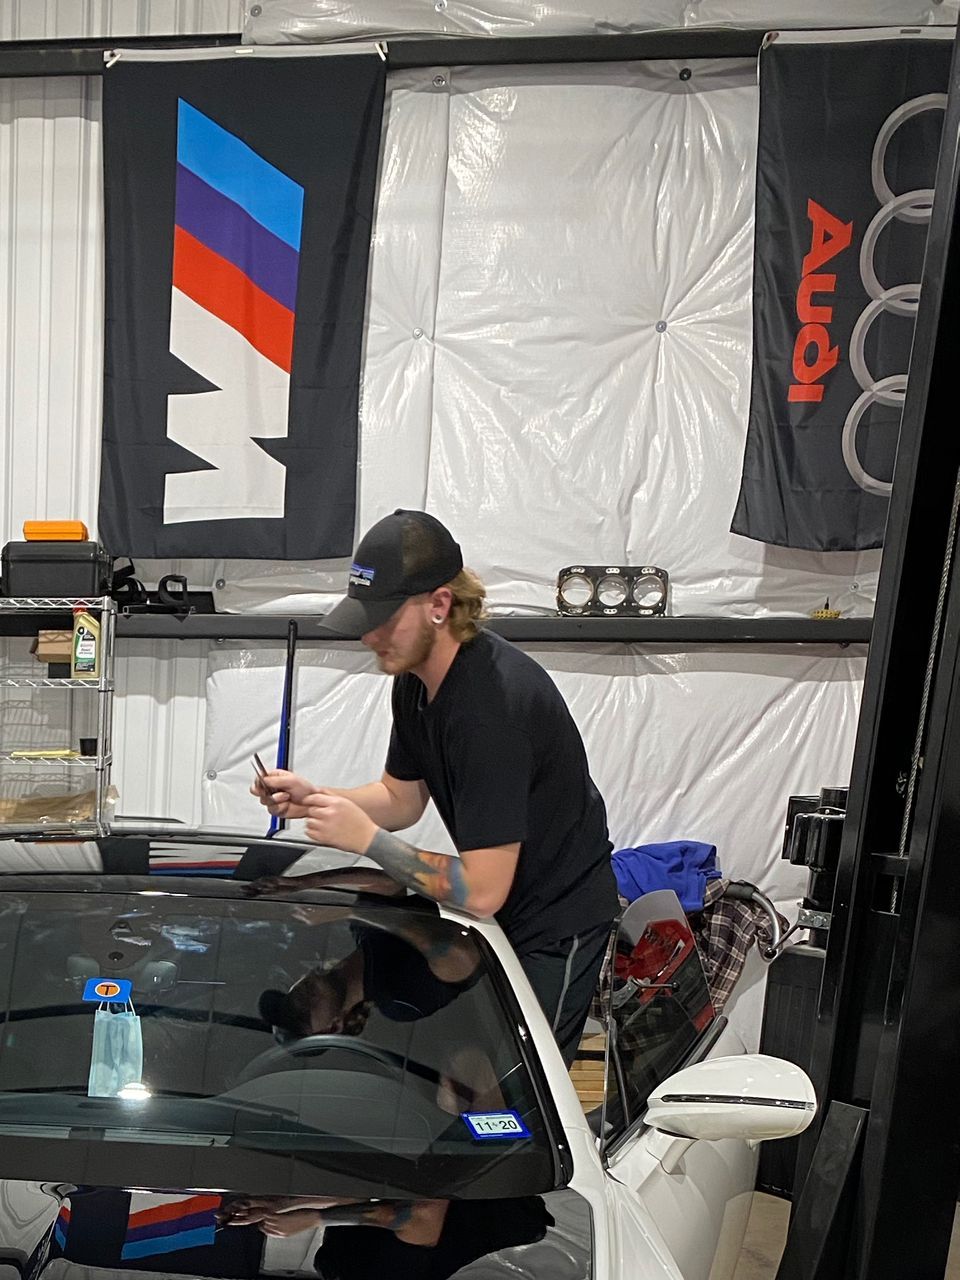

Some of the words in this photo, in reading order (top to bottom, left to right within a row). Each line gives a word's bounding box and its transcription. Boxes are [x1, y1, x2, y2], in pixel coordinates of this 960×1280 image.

[787, 198, 854, 402] Audi
[475, 1122, 493, 1131] 11
[498, 1120, 518, 1130] 20
